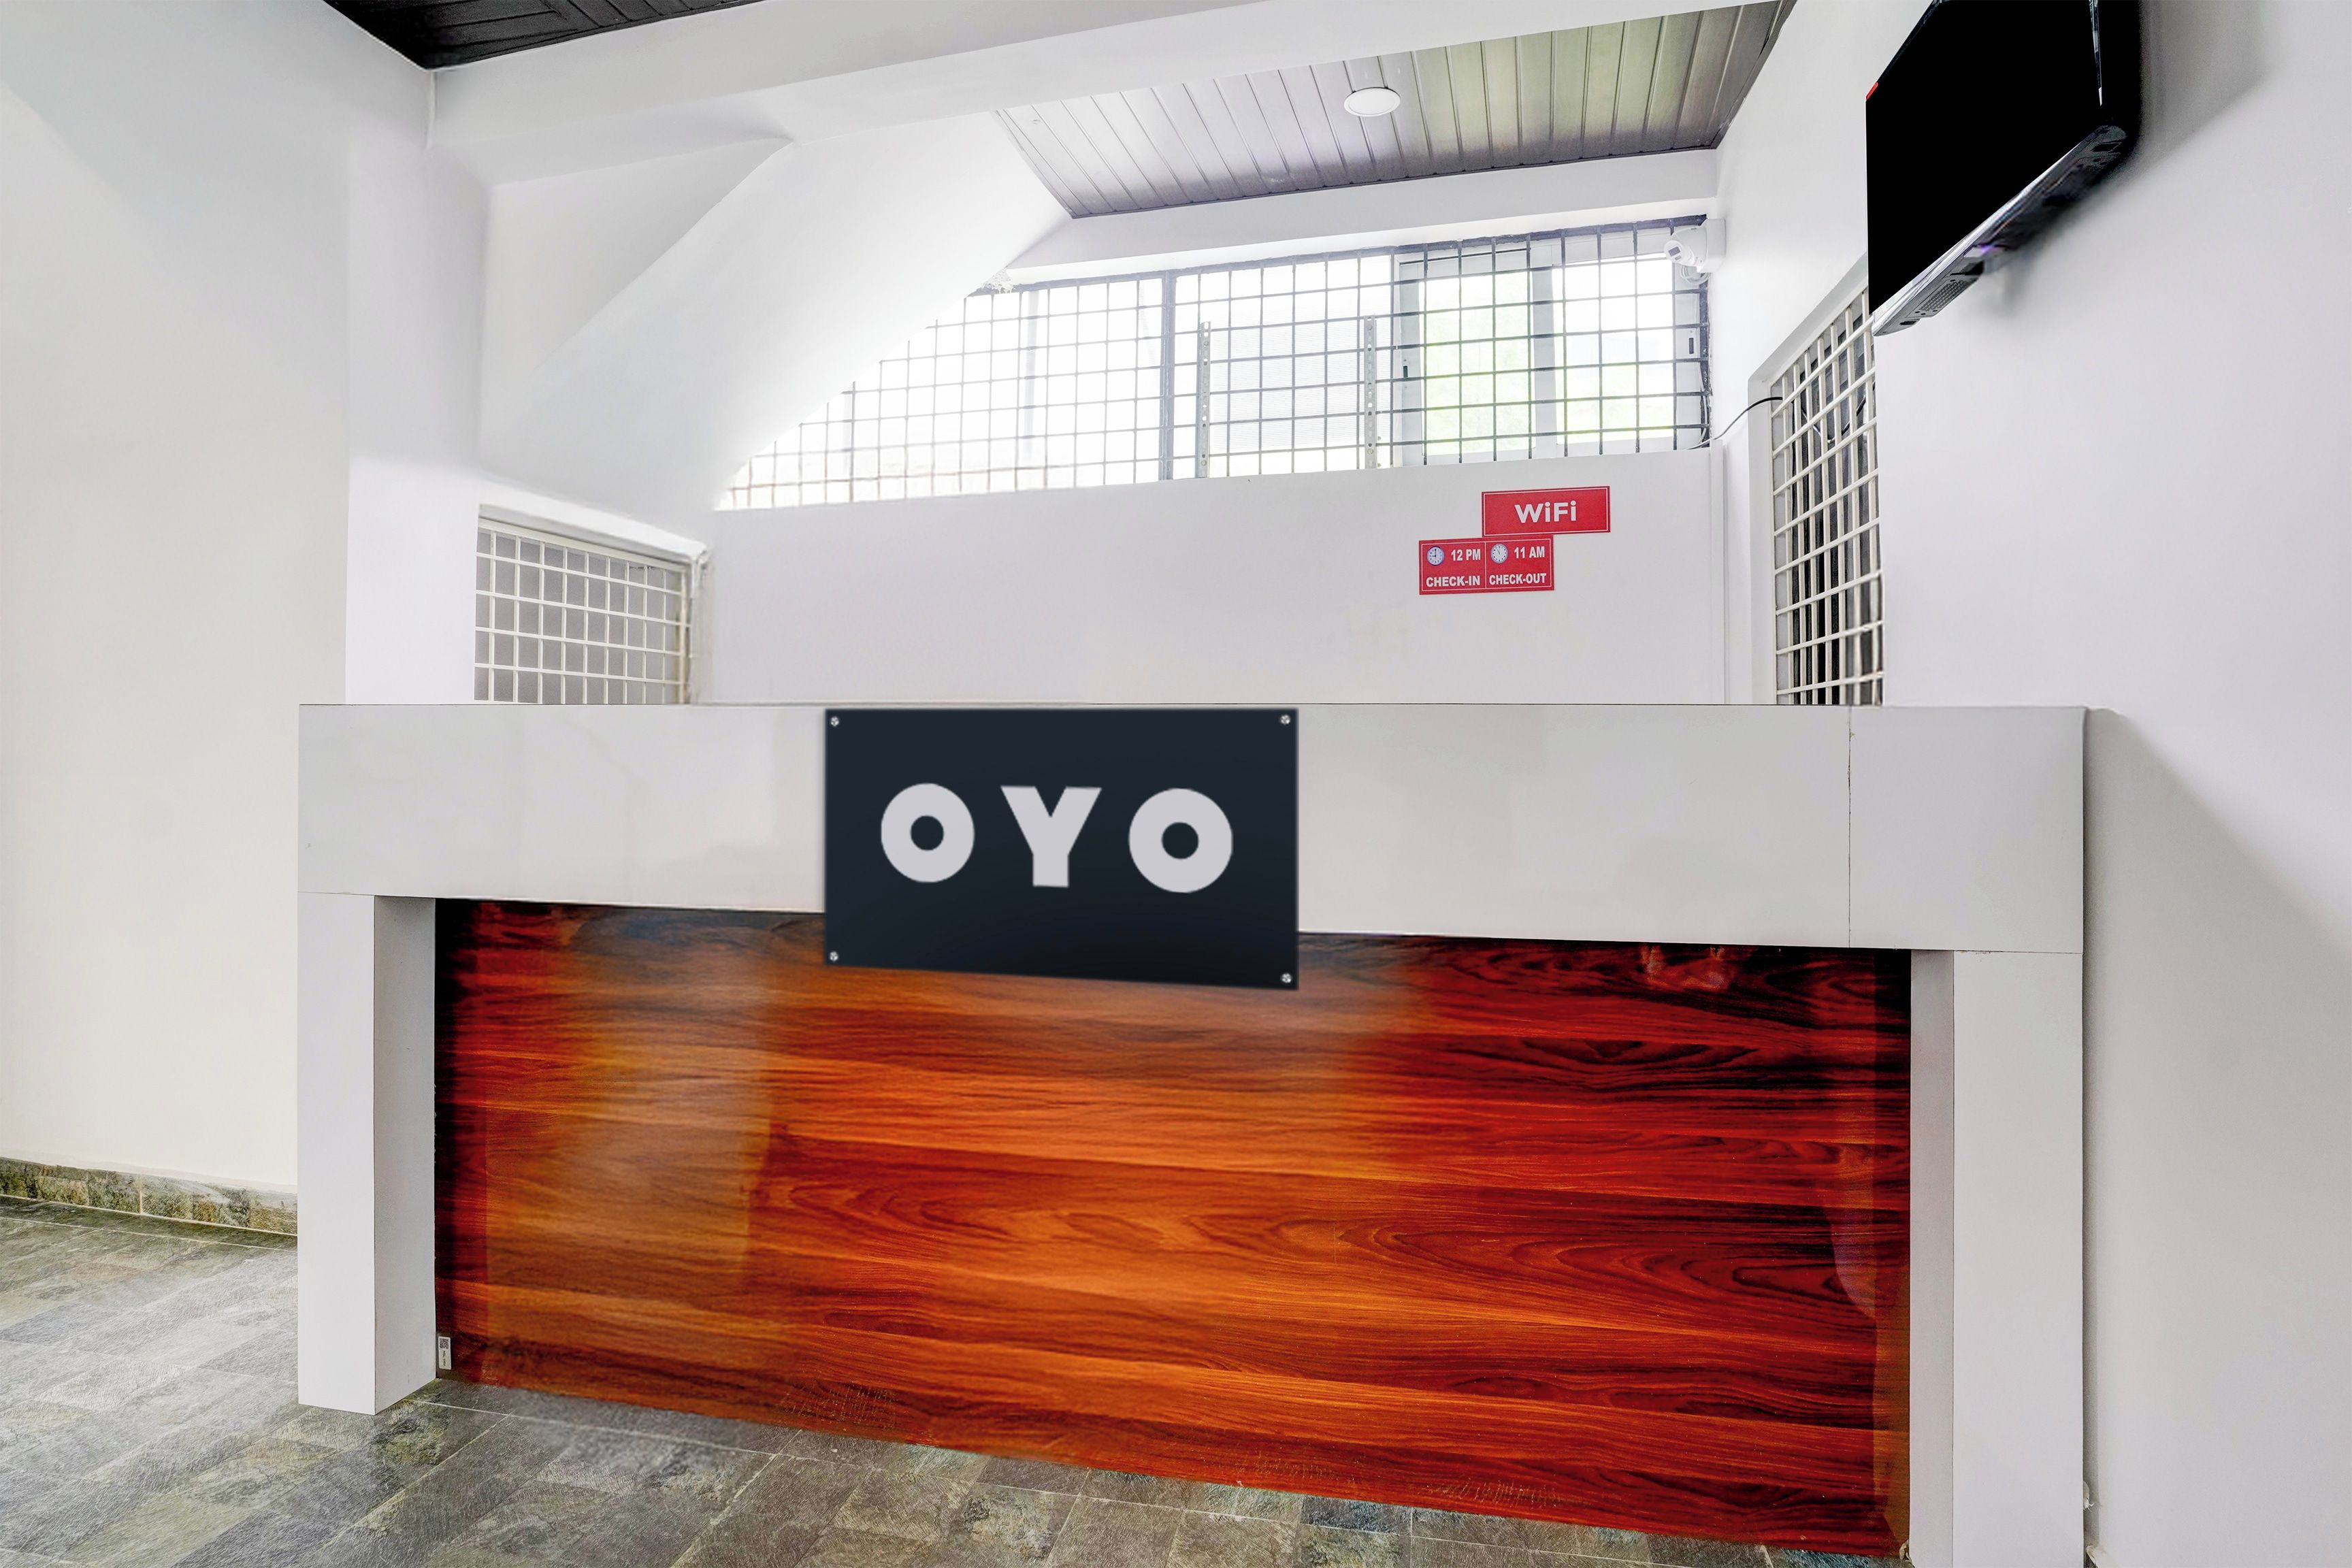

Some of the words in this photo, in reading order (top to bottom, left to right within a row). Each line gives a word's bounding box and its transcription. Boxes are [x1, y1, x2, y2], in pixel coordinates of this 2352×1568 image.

[1514, 500, 1576, 523] WiFi
[1451, 549, 1463, 561] 12
[1466, 549, 1480, 560] PM
[1514, 547, 1525, 558] 11
[1529, 546, 1545, 557] AM
[1426, 575, 1480, 587] CHECK-IN
[1489, 573, 1546, 585] CHECK-OUT
[881, 783, 1233, 893] OYO
